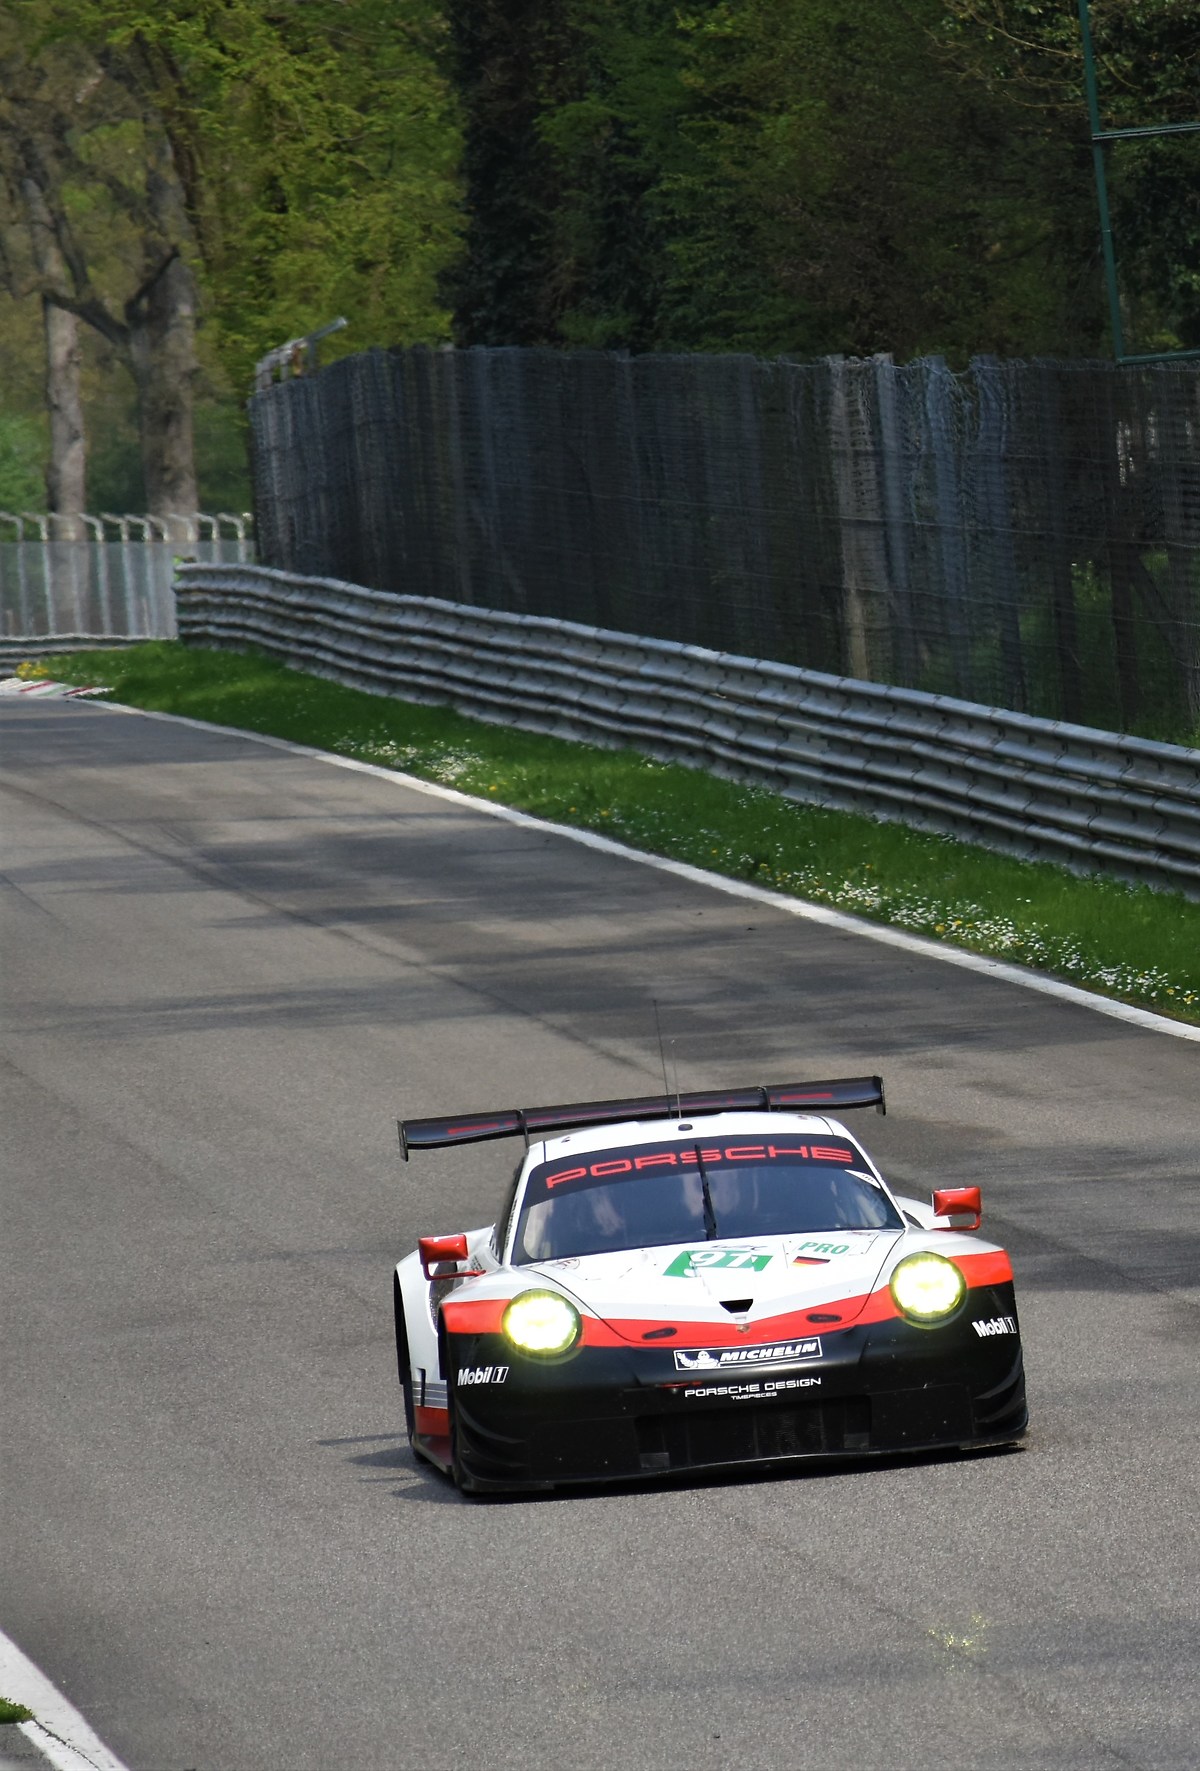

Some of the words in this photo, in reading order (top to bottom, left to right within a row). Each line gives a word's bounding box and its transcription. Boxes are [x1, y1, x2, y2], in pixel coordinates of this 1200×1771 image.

[546, 1145, 853, 1189] PORSCHE
[798, 1241, 851, 1255] PRO
[683, 1251, 756, 1278] 91
[971, 1317, 1009, 1338] Mobil
[720, 1342, 818, 1362] MICHELIN
[457, 1366, 494, 1386] Mobil
[684, 1383, 760, 1398] PORSCHE
[764, 1377, 822, 1391] DESIGN
[731, 1391, 778, 1401] TIMEPIECES
